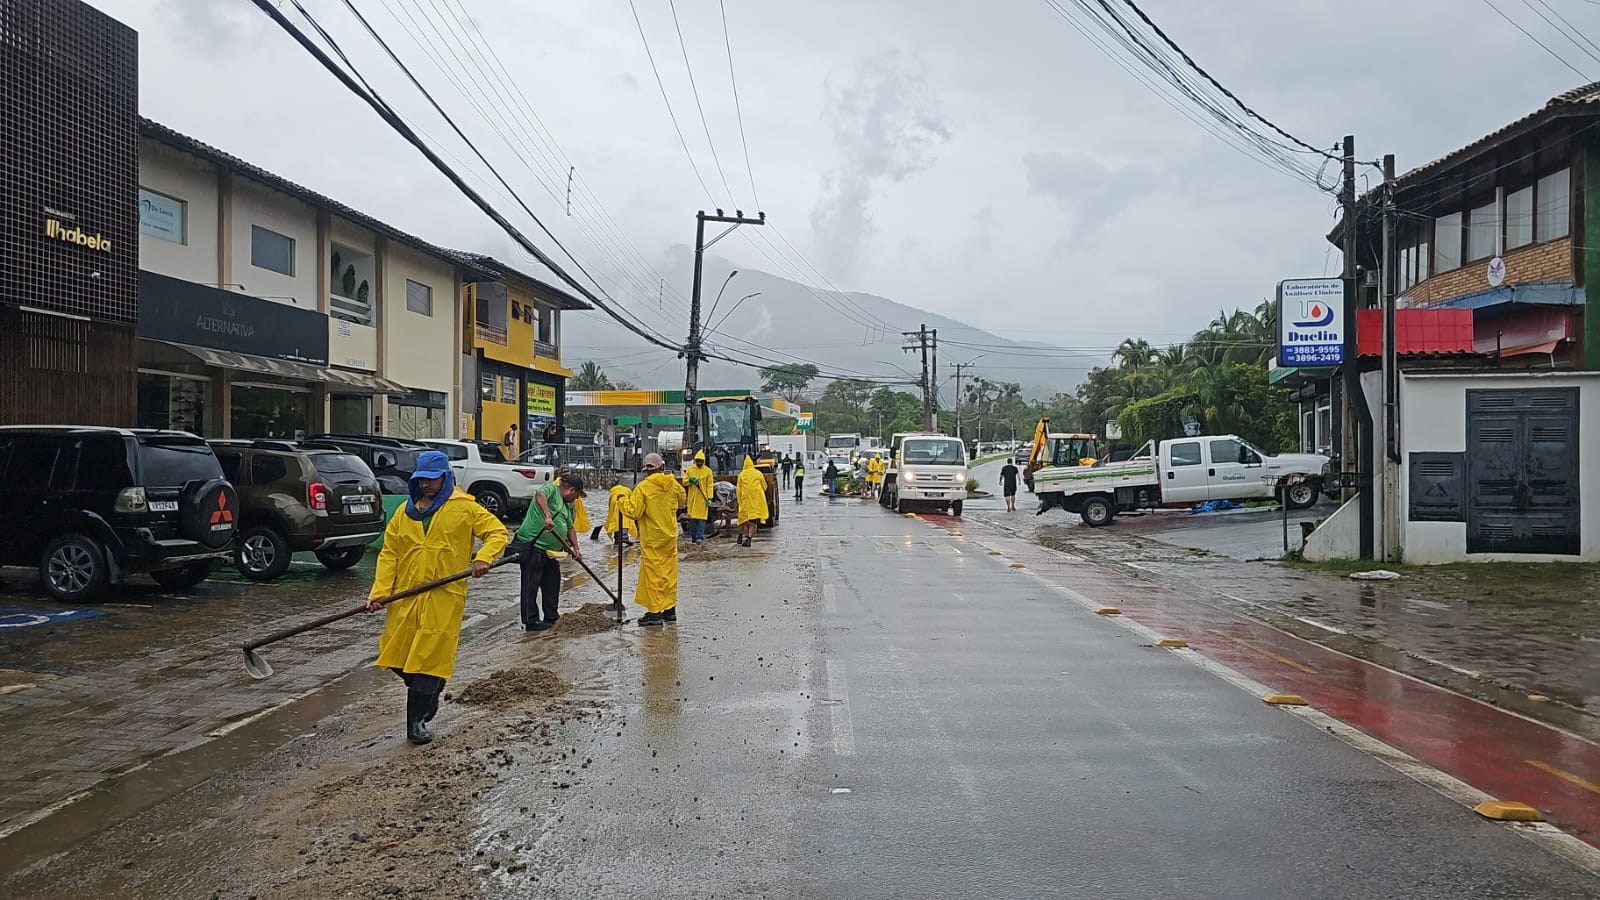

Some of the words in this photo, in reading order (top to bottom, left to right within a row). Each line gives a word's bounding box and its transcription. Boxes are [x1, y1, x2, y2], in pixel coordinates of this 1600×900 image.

[47, 219, 111, 252] Ilhabela
[196, 315, 255, 337] ALTERNATIVA
[1293, 346, 1340, 354] 3883-9595
